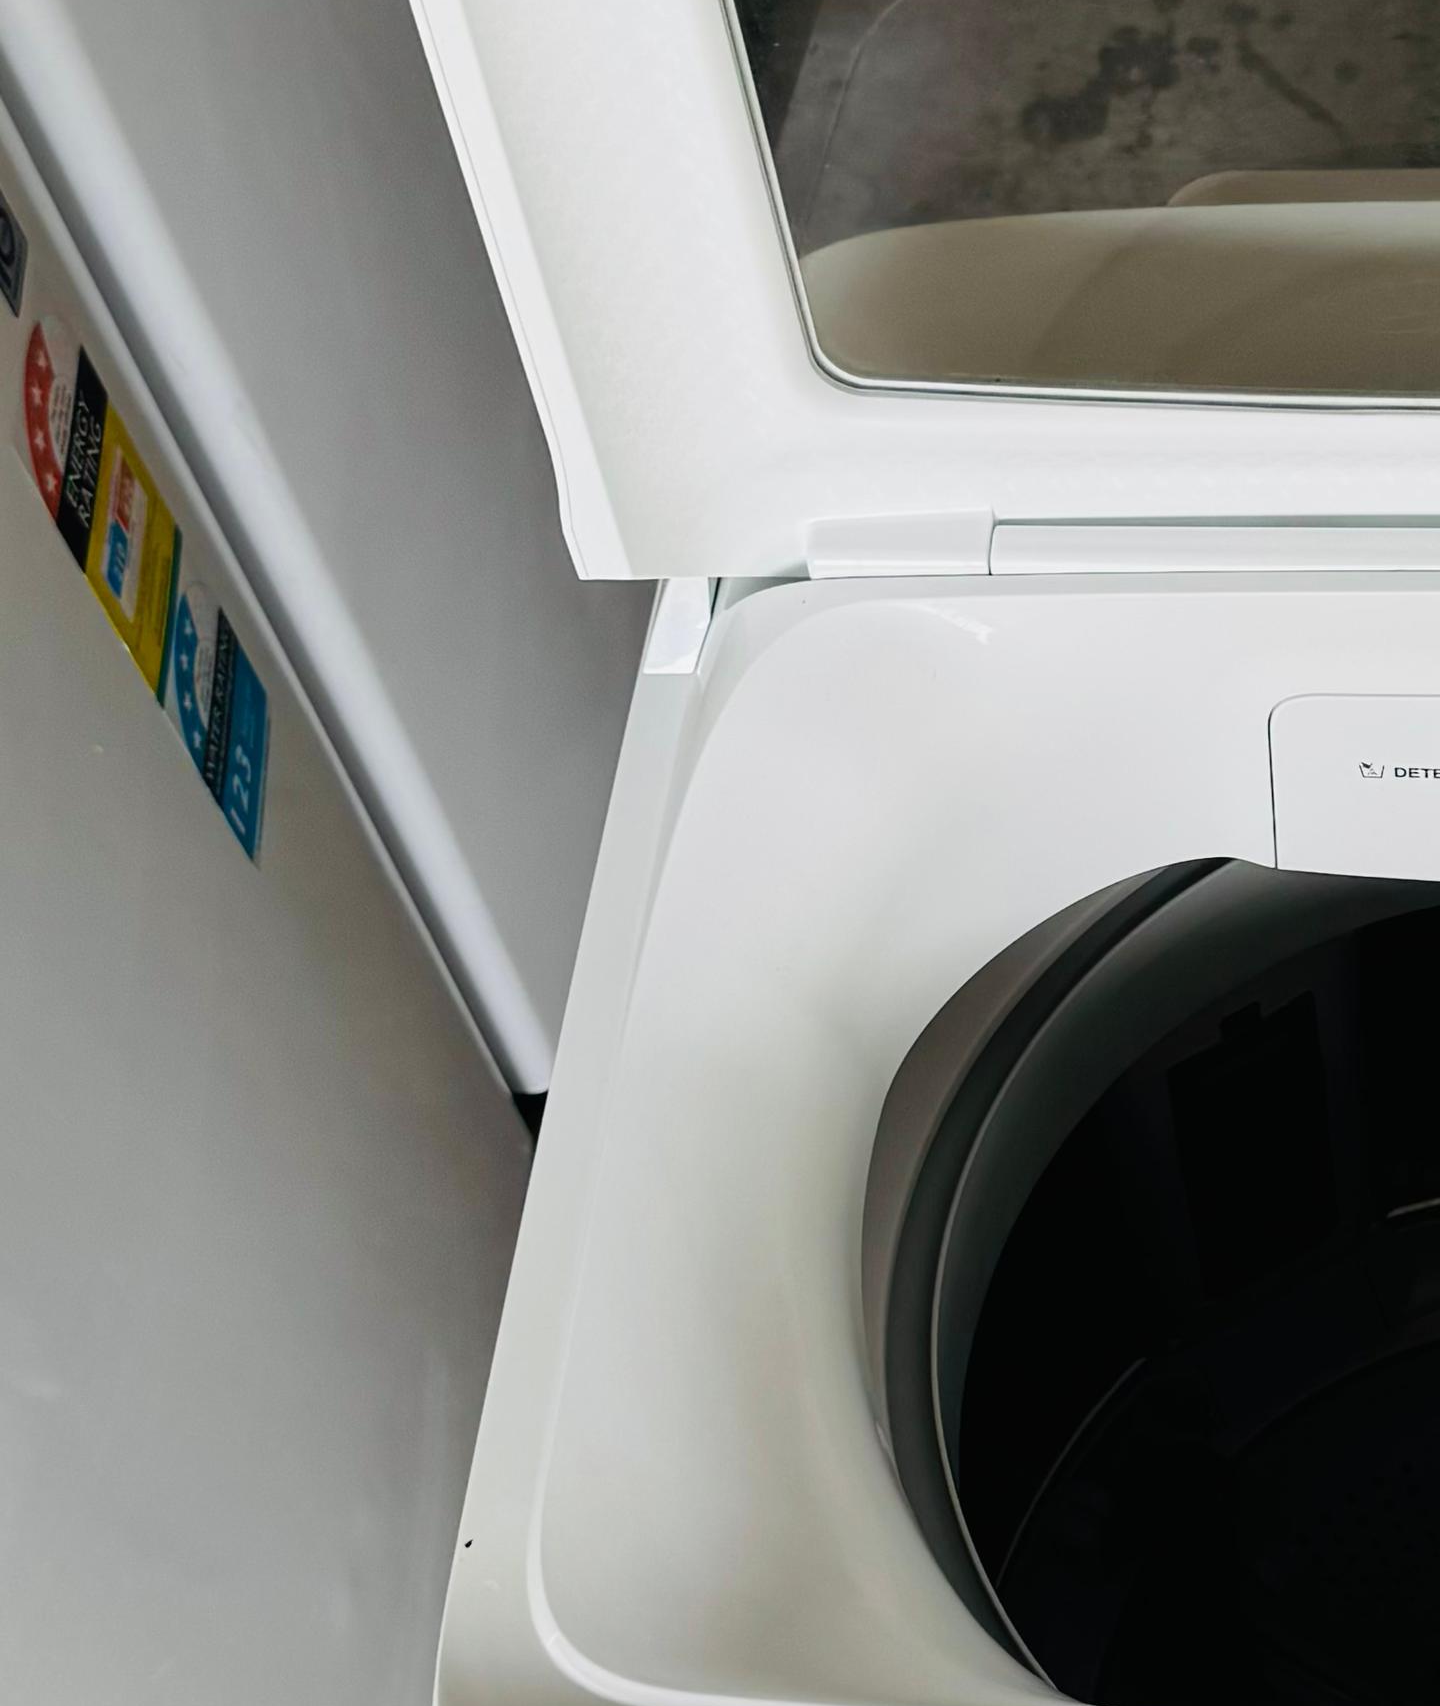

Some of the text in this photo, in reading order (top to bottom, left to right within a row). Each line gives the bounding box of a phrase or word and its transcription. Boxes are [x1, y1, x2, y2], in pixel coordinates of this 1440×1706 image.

[65, 389, 90, 509] ENERGY
[77, 414, 102, 529] RATING
[229, 744, 252, 835] 123
